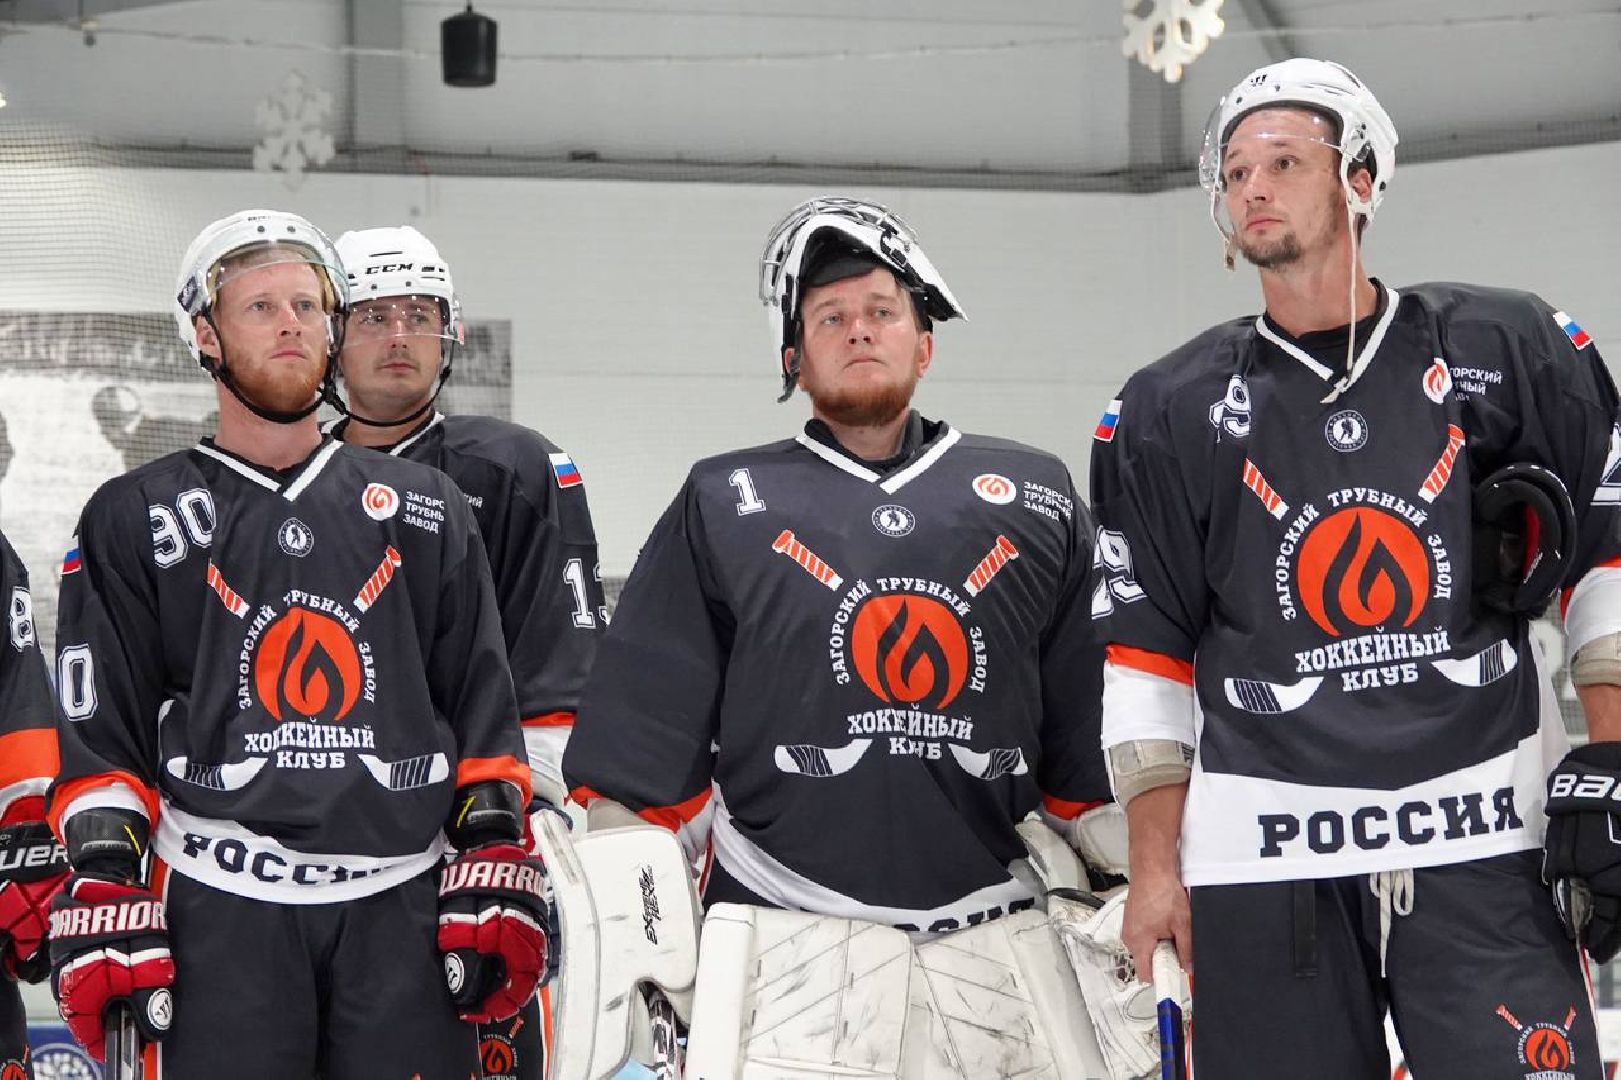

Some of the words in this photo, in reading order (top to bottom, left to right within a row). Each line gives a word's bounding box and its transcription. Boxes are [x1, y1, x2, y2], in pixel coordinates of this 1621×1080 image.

[365, 263, 413, 274] CCM
[1450, 368, 1502, 384] ГОРСКИЙ
[405, 491, 445, 510] ЗАГОРС
[729, 468, 766, 516] 1
[1024, 501, 1060, 521] ЗАВОД
[149, 488, 216, 568] 90
[403, 514, 439, 534] ЗАВОД
[1276, 503, 1320, 621] ЗАГОРСКИЙ
[1327, 488, 1428, 527] ТРУБНЫЙ
[1428, 534, 1452, 599] ЗАВОД
[563, 558, 610, 629] 1
[238, 605, 277, 710] ЗАГОРСКИЙ
[283, 589, 360, 633] ТРУБНЫЙ
[358, 642, 376, 703] ЗАВОД
[830, 579, 871, 685] ЗАГОРСКИЙ
[876, 577, 971, 617] ТРУБНЫЙ
[969, 626, 987, 693] ЗАВОД
[1295, 625, 1451, 673] ХОККЕЙНЫЙ
[1341, 663, 1419, 691] КЛУБ
[276, 752, 346, 769] КЛУБ
[1258, 786, 1524, 858] РОССИЯ
[183, 832, 393, 885] РОСС
